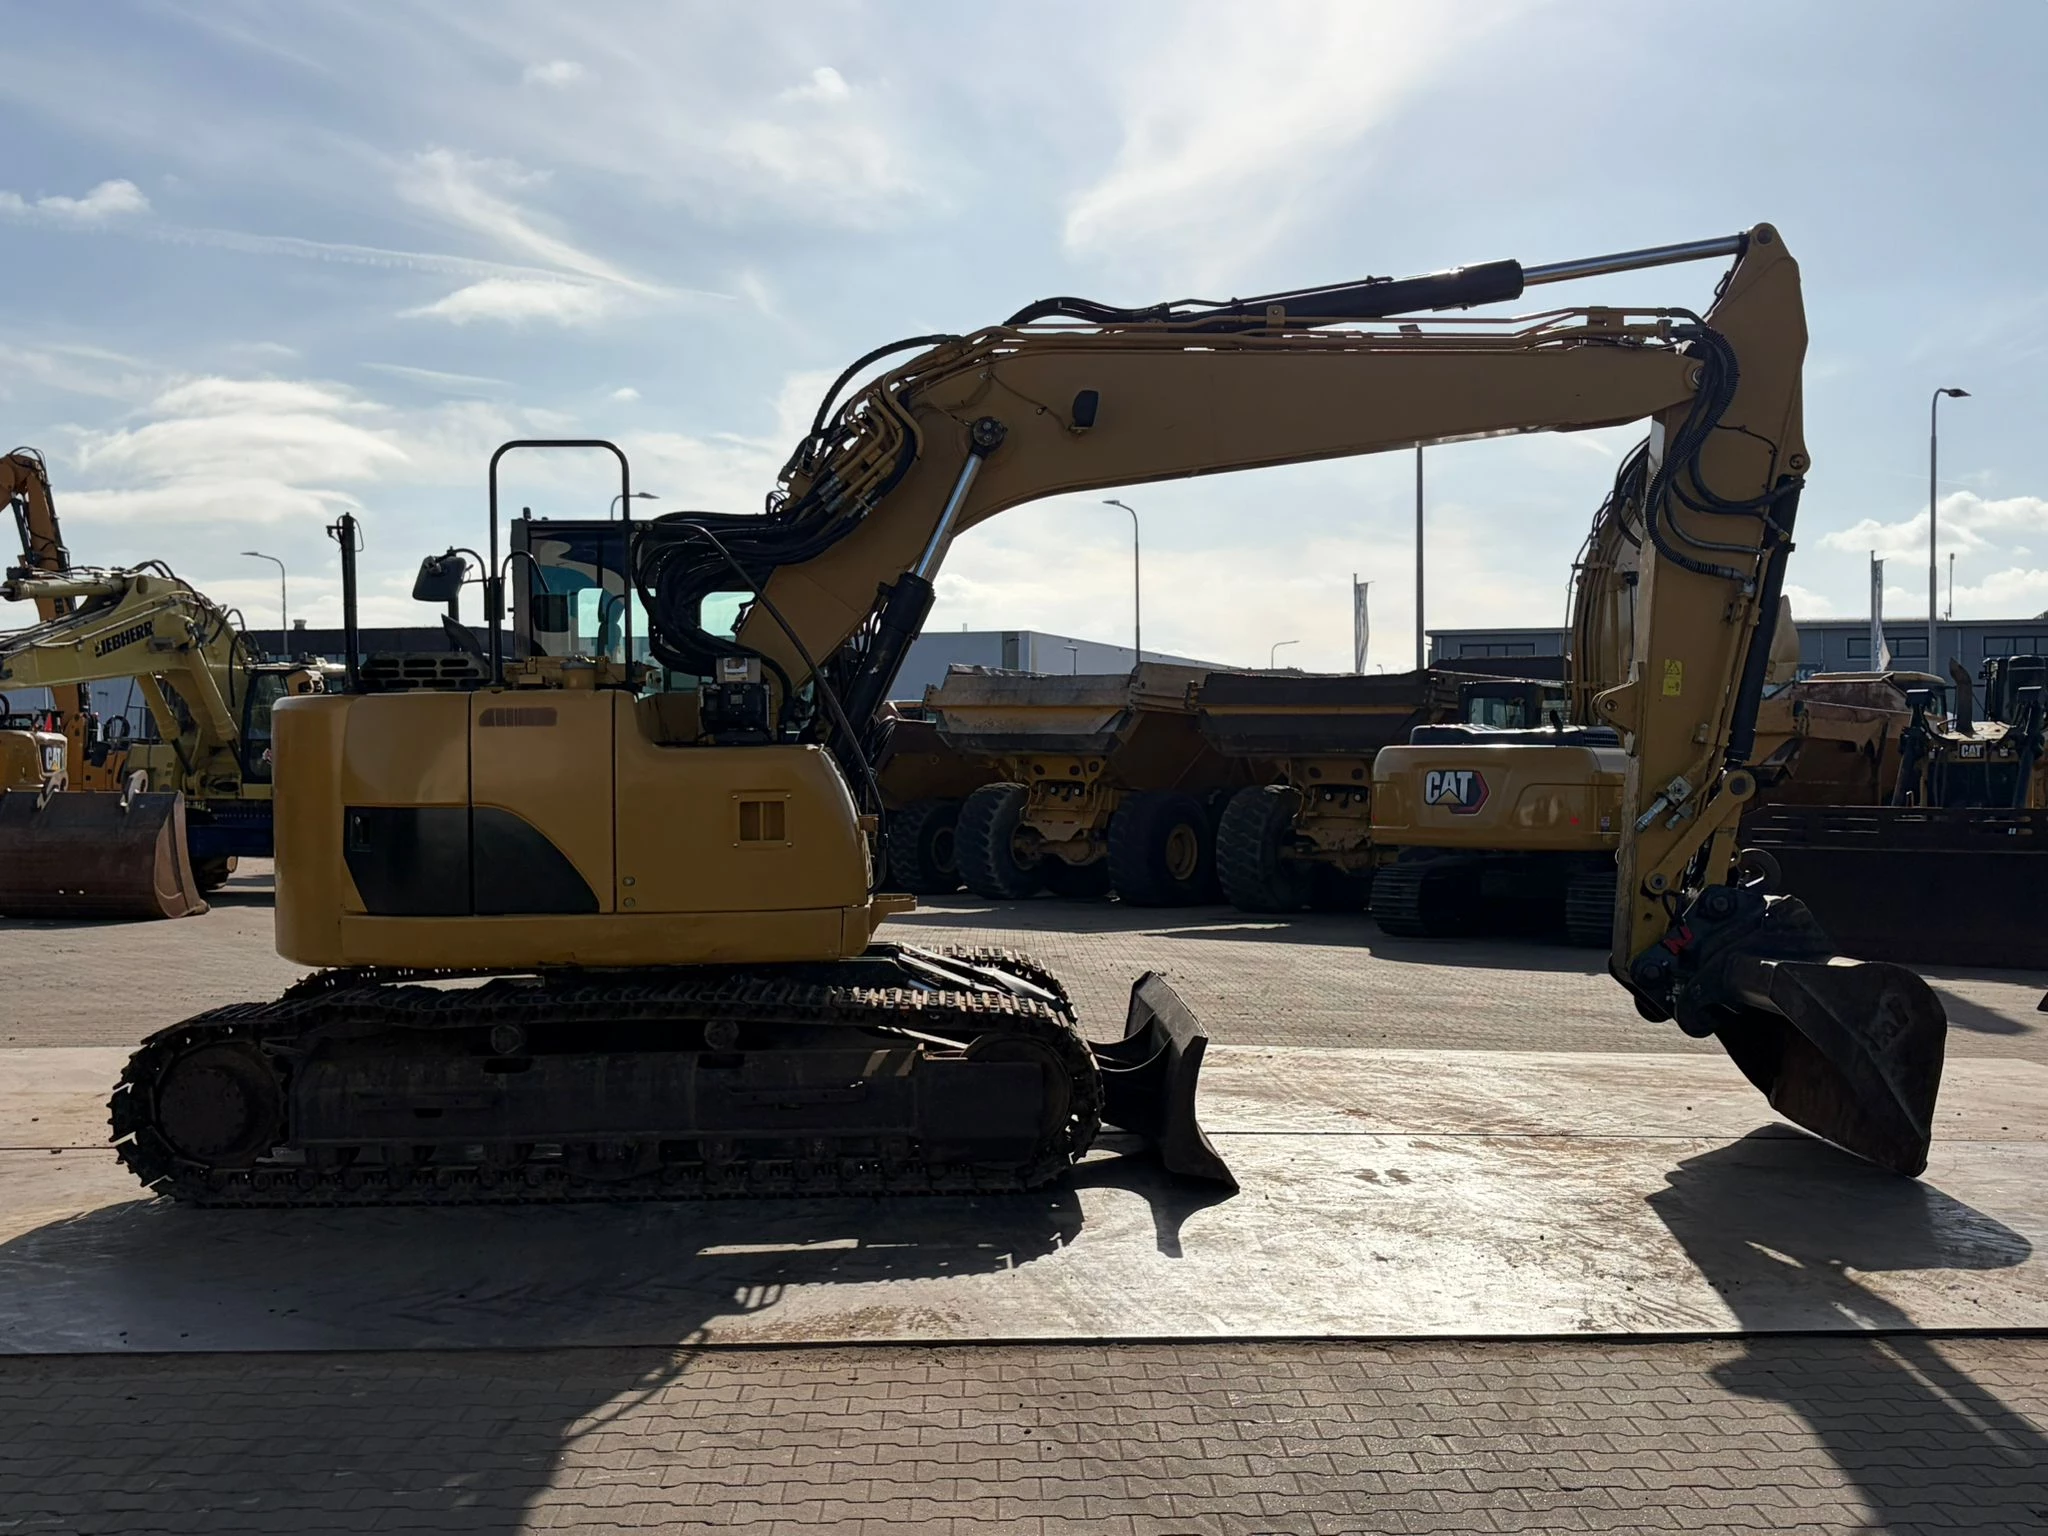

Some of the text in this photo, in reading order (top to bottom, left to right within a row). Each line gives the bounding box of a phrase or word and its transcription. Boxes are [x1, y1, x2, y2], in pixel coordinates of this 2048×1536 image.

[46, 747, 62, 770] CAT
[1961, 744, 1982, 758] CAT
[1426, 771, 1473, 805] CAT
